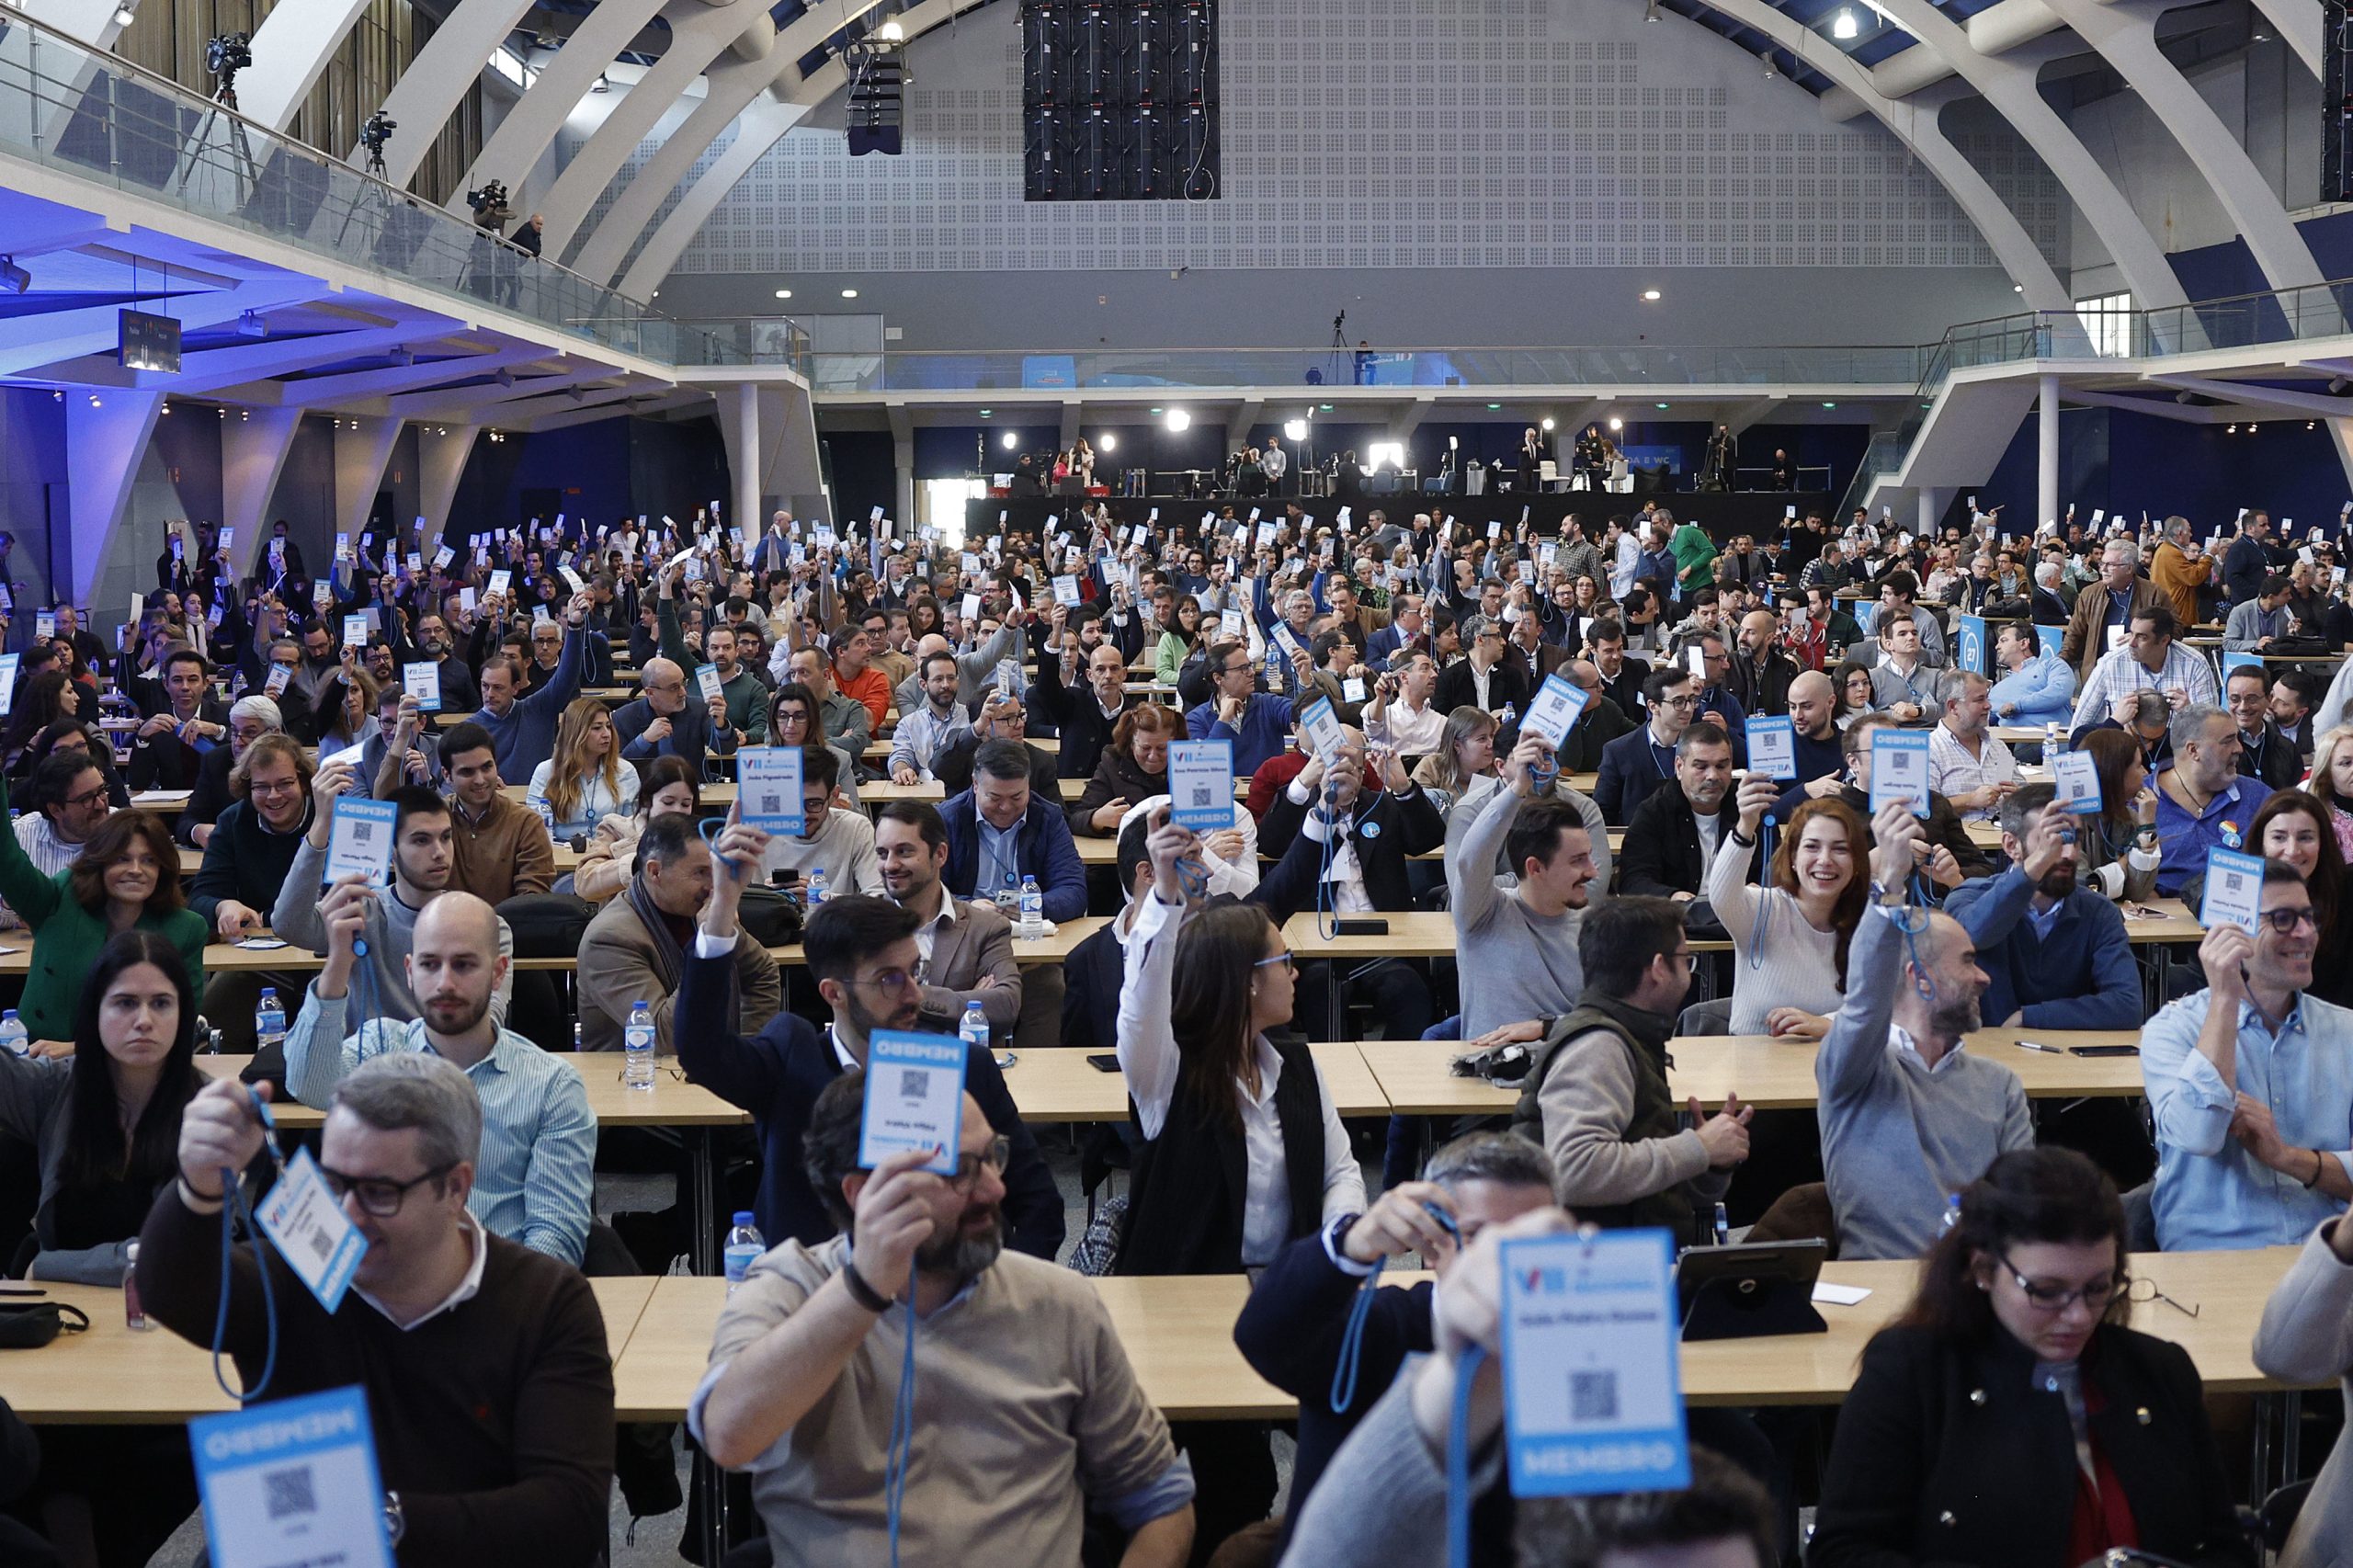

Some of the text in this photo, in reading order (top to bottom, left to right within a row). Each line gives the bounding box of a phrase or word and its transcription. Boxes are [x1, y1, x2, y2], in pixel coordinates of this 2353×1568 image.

[1654, 456, 1670, 464] WC
[1967, 647, 1976, 663] 27
[1548, 678, 1585, 703] MEMBRO
[1749, 720, 1789, 730] MEMBRO
[1876, 734, 1927, 746] MEMBRO
[742, 758, 762, 770] VII
[1173, 752, 1193, 763] VII
[338, 802, 392, 817] MEMBRO
[1175, 812, 1231, 826] MEMBRO
[2212, 853, 2260, 872] MEMBRO
[876, 1040, 960, 1062] MEMBRO
[1514, 1267, 1566, 1296] VII
[204, 1407, 357, 1461] MEMBRO
[1523, 1442, 1677, 1476] MEMBRO
